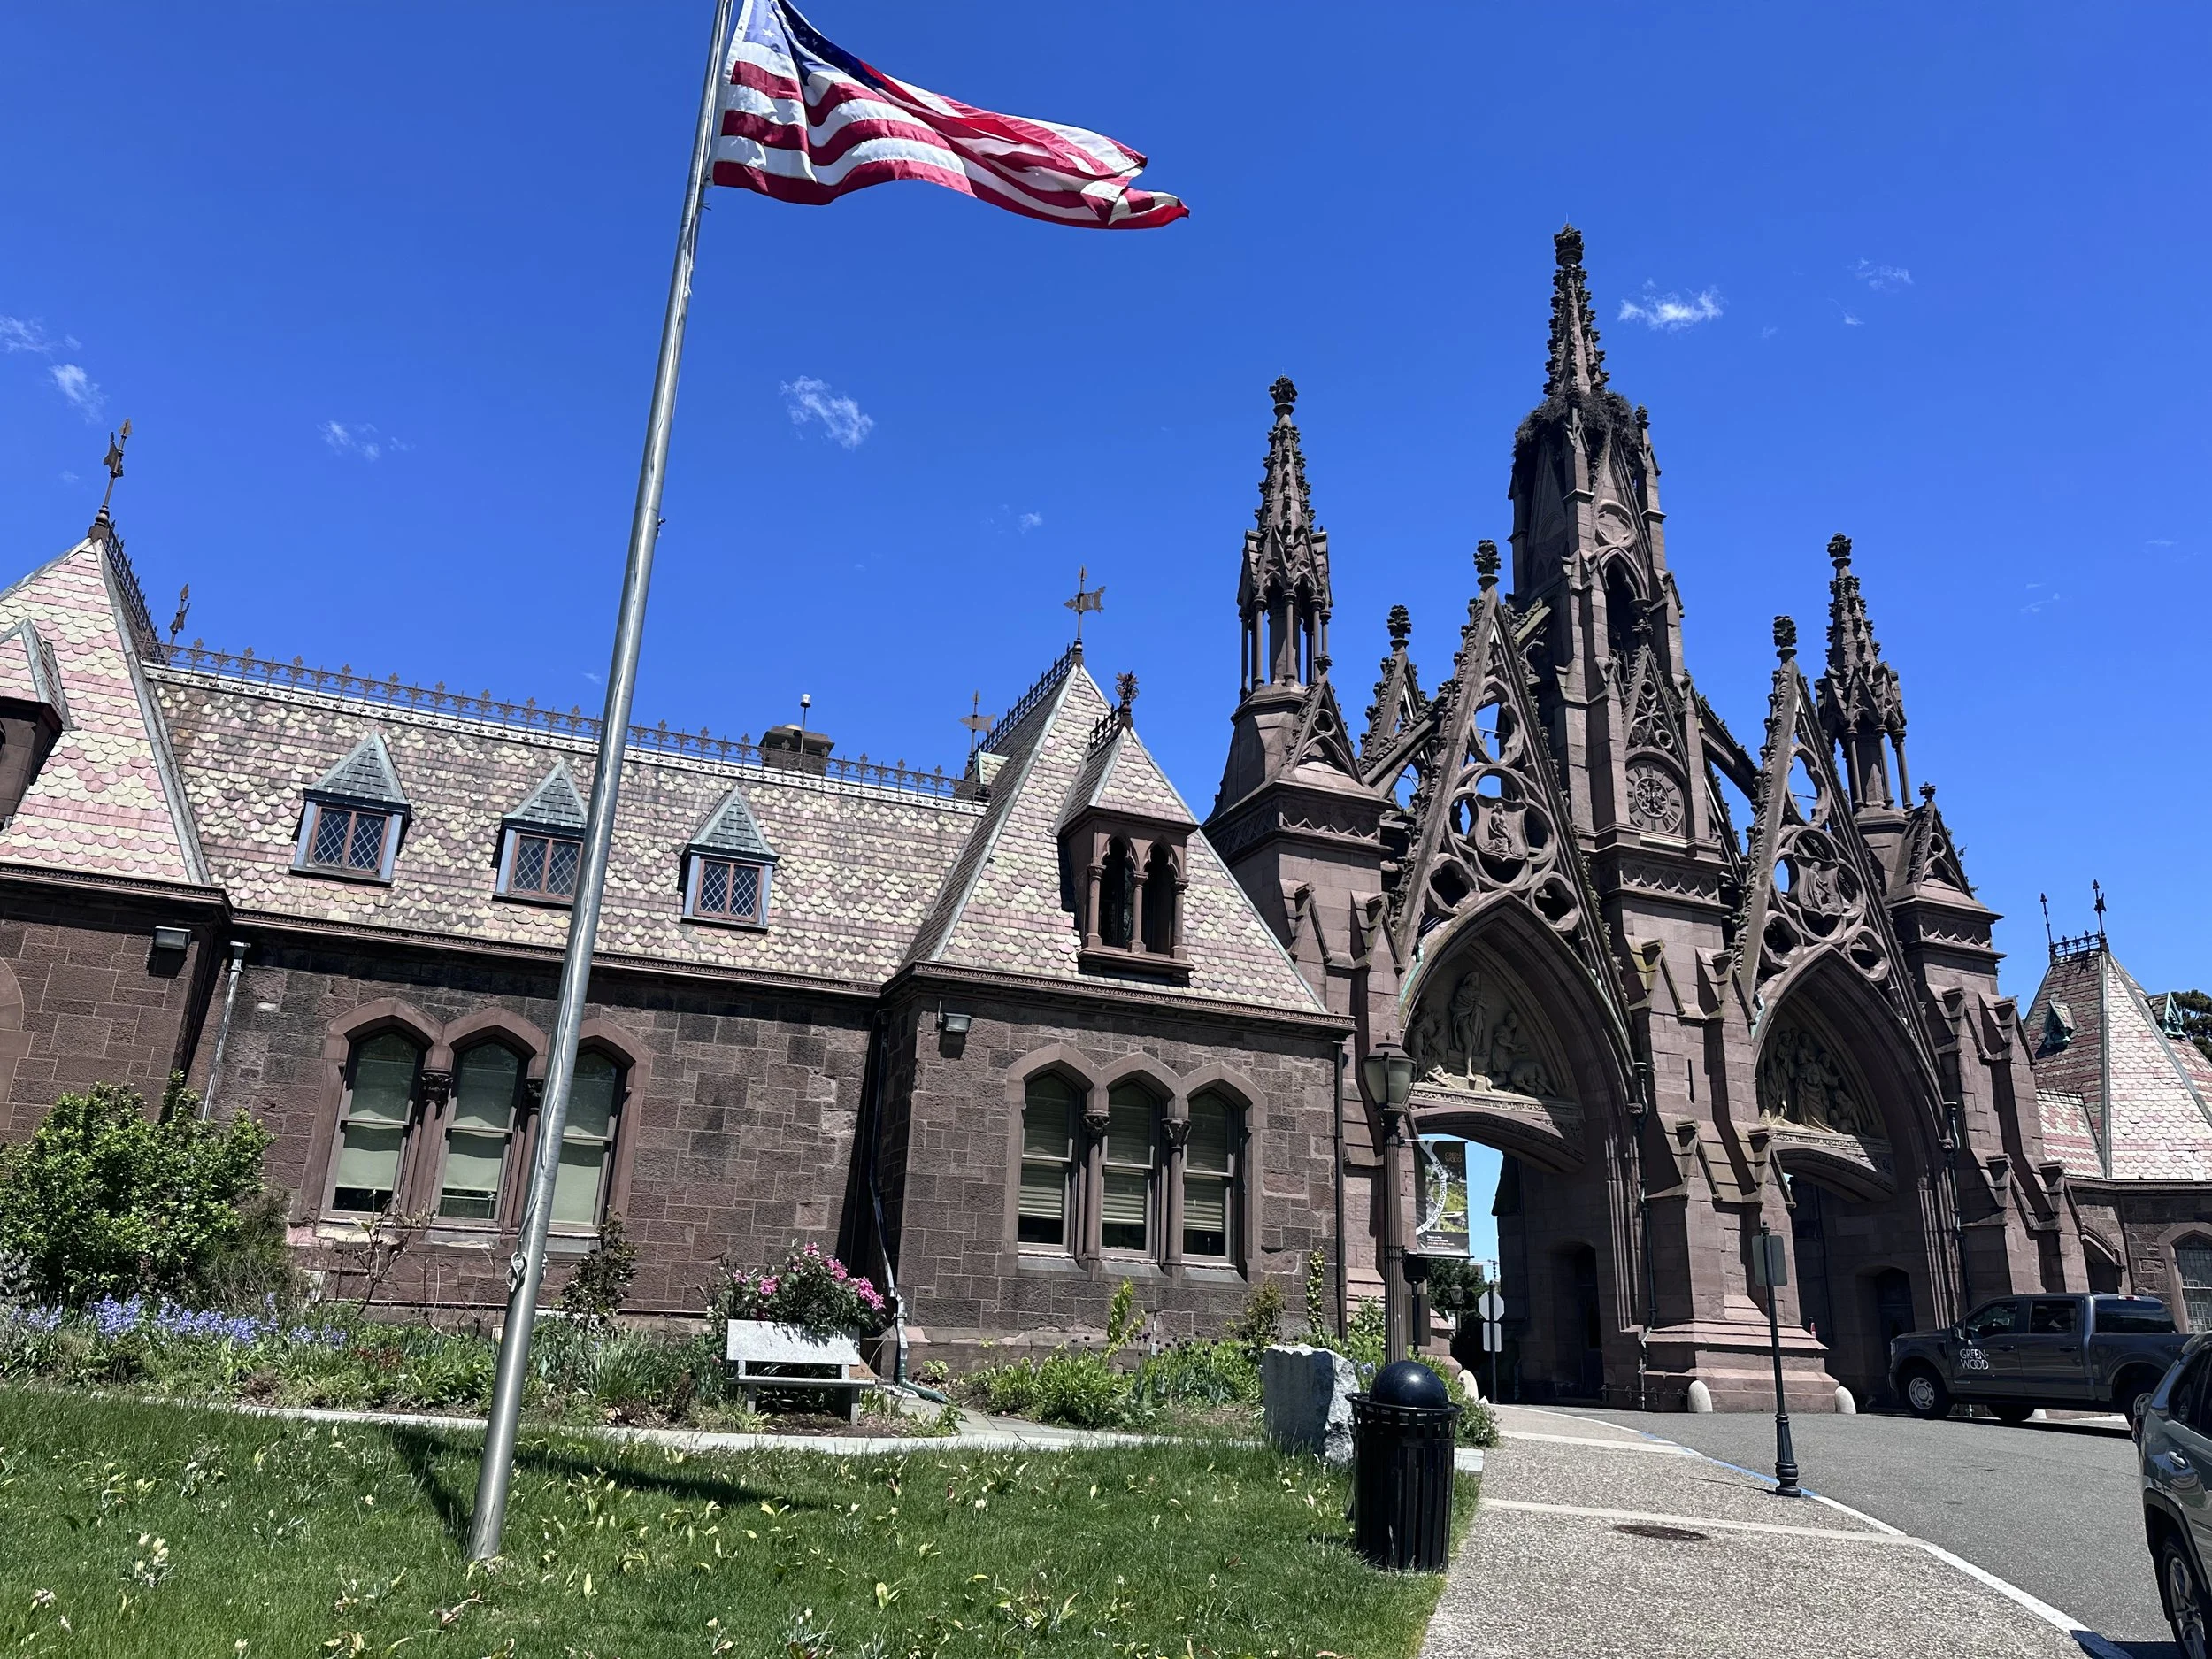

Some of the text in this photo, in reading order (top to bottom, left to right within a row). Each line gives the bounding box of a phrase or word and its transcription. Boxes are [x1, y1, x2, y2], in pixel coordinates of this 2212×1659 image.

[1435, 1160, 1444, 1177] WALK
[1432, 1205, 1442, 1221] YOUR
[1959, 1348, 1990, 1360] GREEN-
[1960, 1359, 1989, 1370] WOOD
